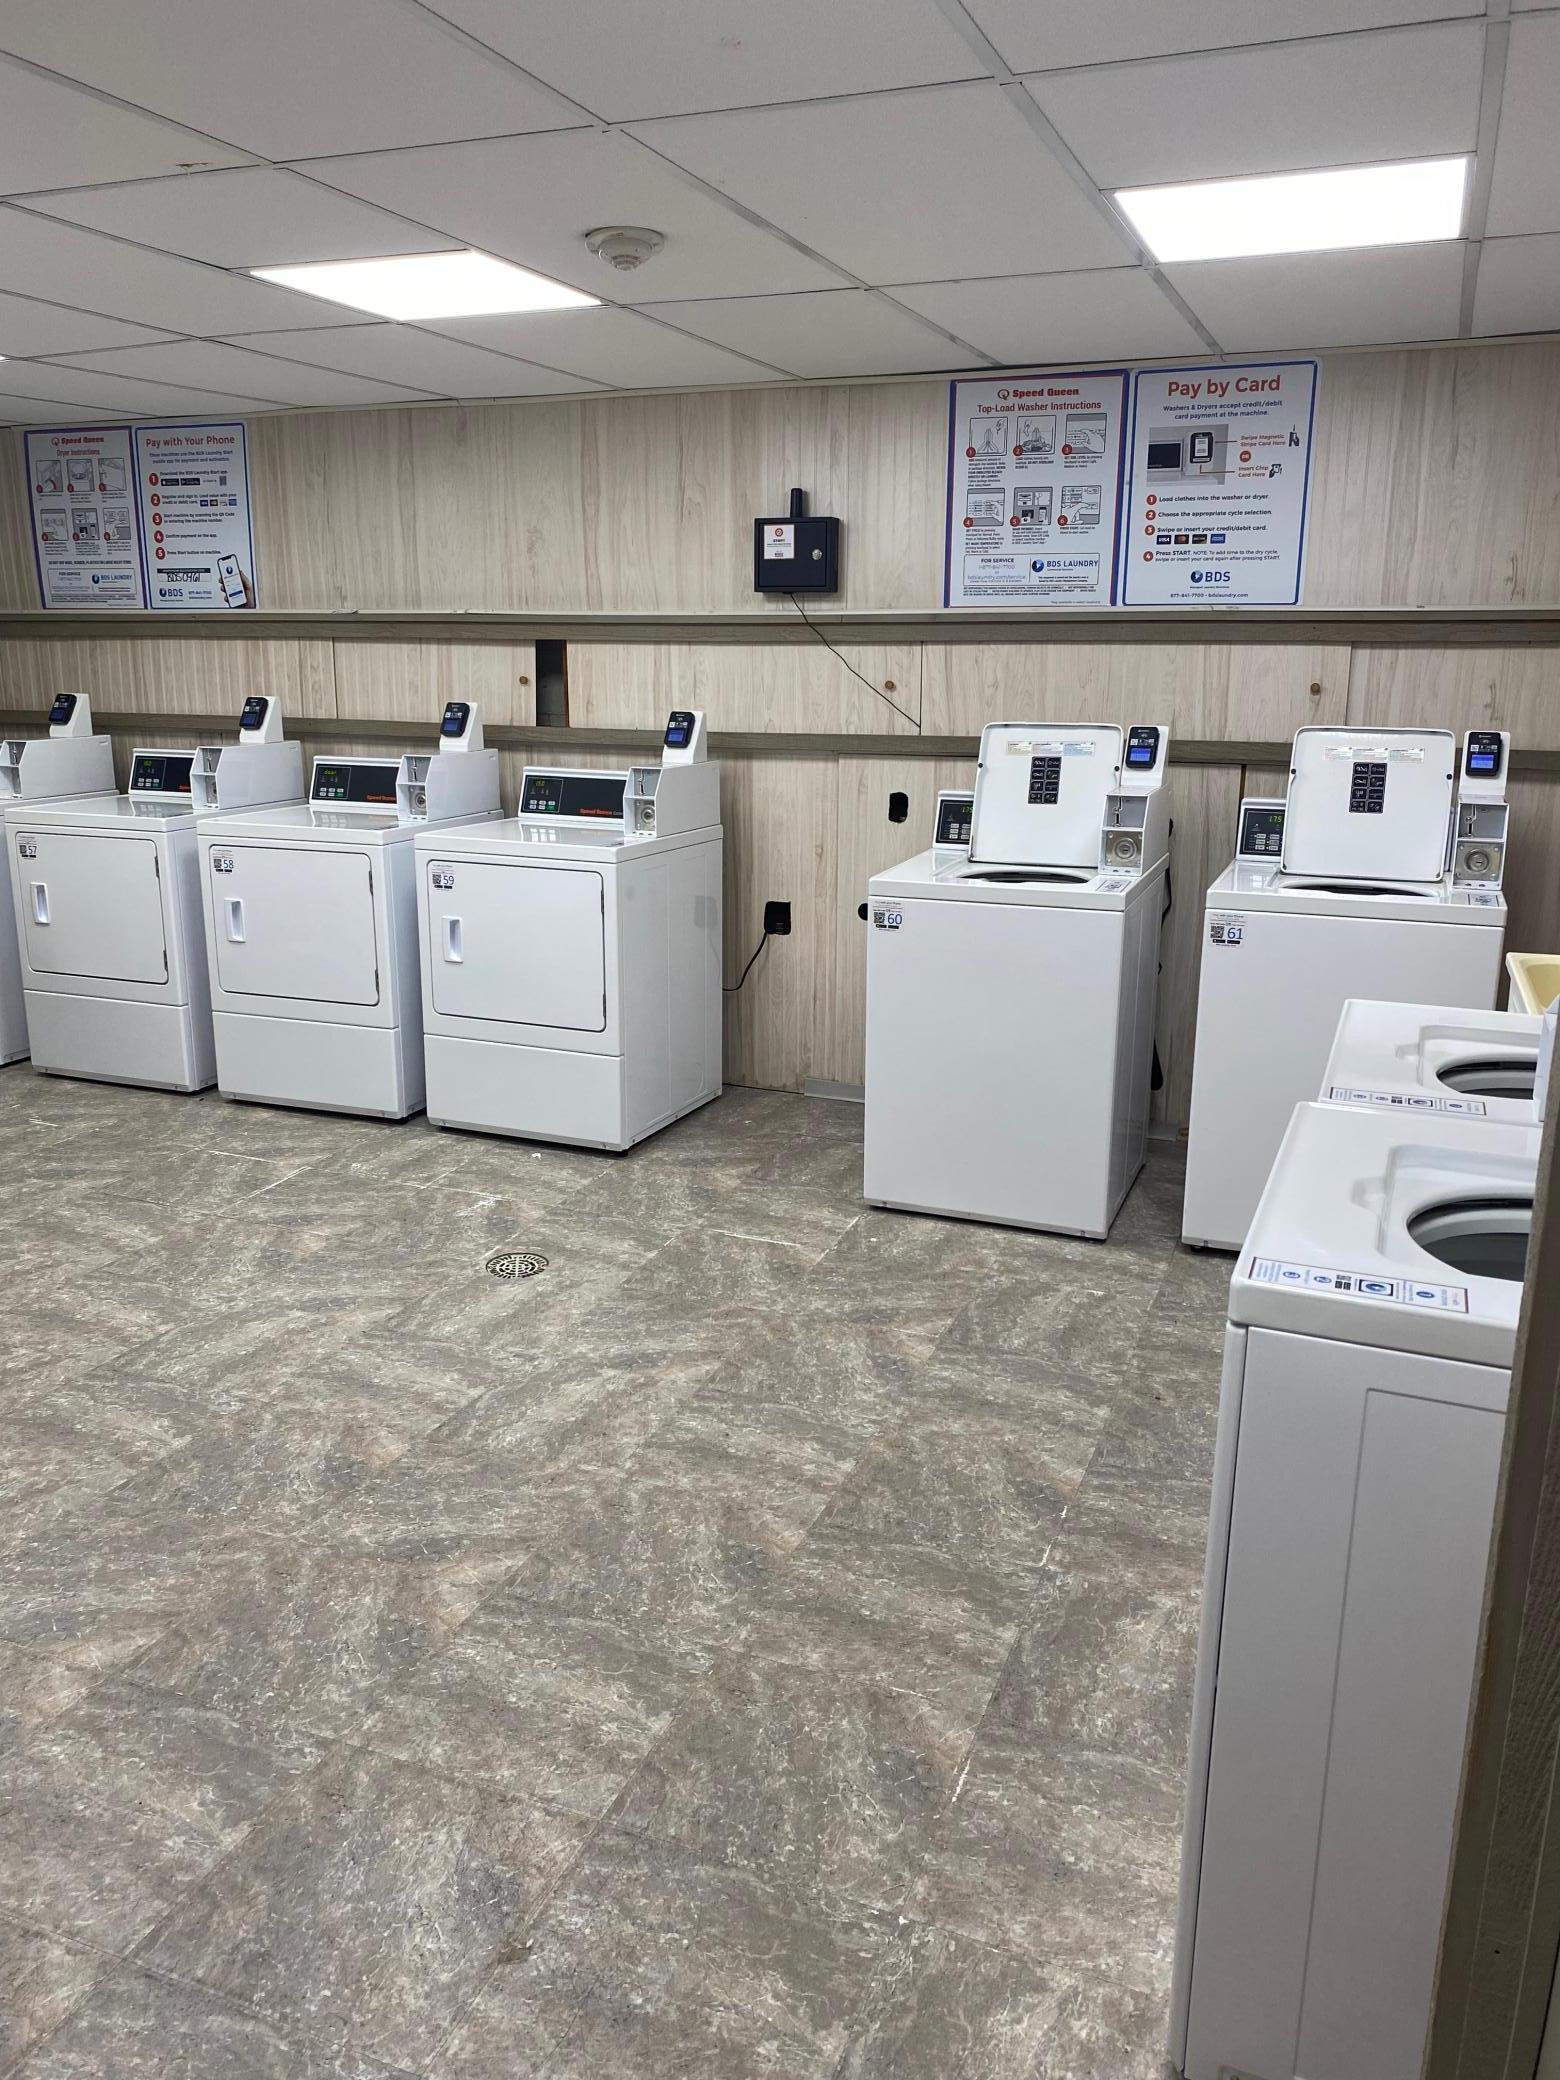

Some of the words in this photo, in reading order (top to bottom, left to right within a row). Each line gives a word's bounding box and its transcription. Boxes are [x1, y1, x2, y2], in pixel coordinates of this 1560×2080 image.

[1168, 382, 1201, 399] Pay
[1207, 379, 1230, 397] by
[1235, 375, 1280, 392] Card
[1013, 389, 1044, 398] Speed
[1047, 388, 1079, 396] Queen
[977, 402, 1015, 414] Top-Load
[1017, 402, 1048, 411] Washer
[1051, 401, 1101, 410] Instructions
[146, 439, 160, 448] Pay
[163, 437, 182, 446] with
[184, 437, 203, 445] Your
[207, 436, 235, 444] Phone
[1205, 572, 1230, 582] BDS
[168, 589, 183, 597] BDS
[28, 846, 37, 854] 57
[224, 860, 233, 868] 58
[443, 876, 454, 885] 59
[888, 914, 902, 924] 60
[1228, 928, 1243, 939] 61
